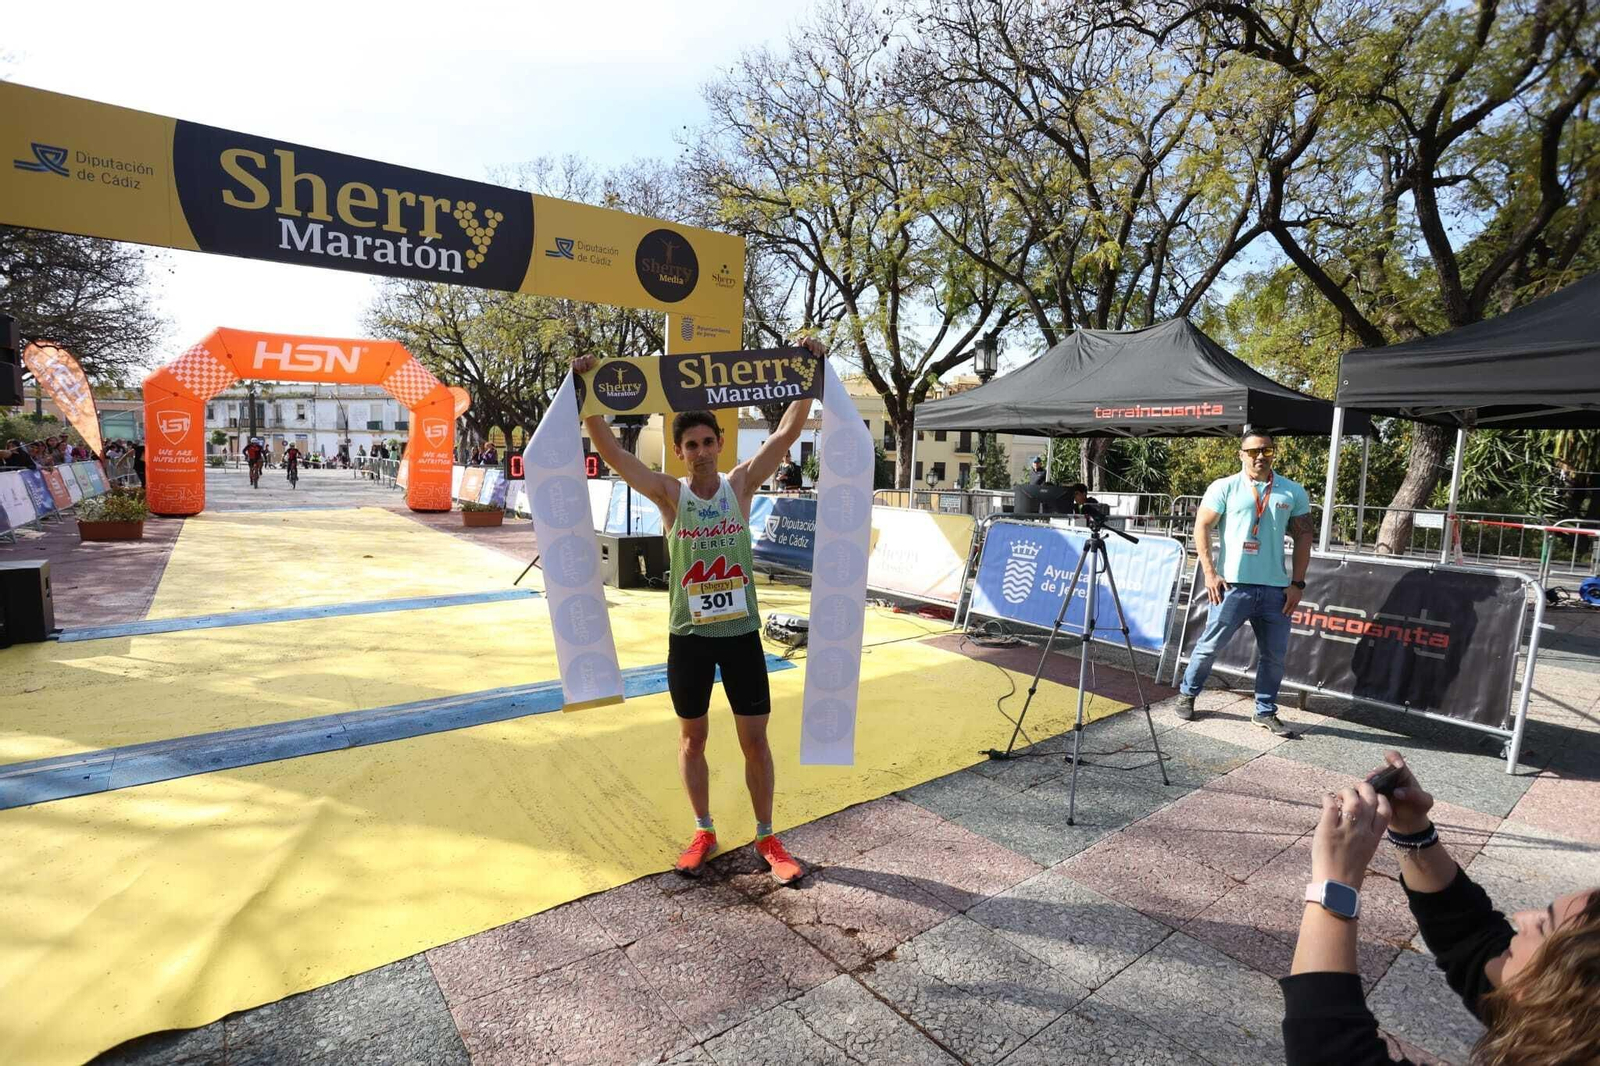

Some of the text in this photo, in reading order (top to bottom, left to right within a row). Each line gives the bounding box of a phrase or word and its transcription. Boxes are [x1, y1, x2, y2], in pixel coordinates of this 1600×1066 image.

[75, 150, 154, 176] Diputación
[76, 168, 141, 190] de Cádiz
[219, 148, 504, 269] Sherry
[278, 217, 464, 274] Maratón
[577, 240, 619, 256] Diputación
[577, 253, 612, 266] de Cádiz
[641, 257, 692, 284] Sherry
[659, 273, 685, 285] Media
[252, 340, 361, 374] HSN
[678, 354, 818, 391] Sherry
[598, 382, 641, 395] Sherry
[706, 380, 802, 405] Maratón
[1094, 402, 1224, 420] terraincognita
[158, 448, 174, 456] WE
[677, 517, 744, 539] maratón
[691, 537, 736, 550] JEREZ
[778, 533, 810, 548] de Cádiz
[1040, 579, 1089, 600] de Jere
[700, 591, 734, 611] 301
